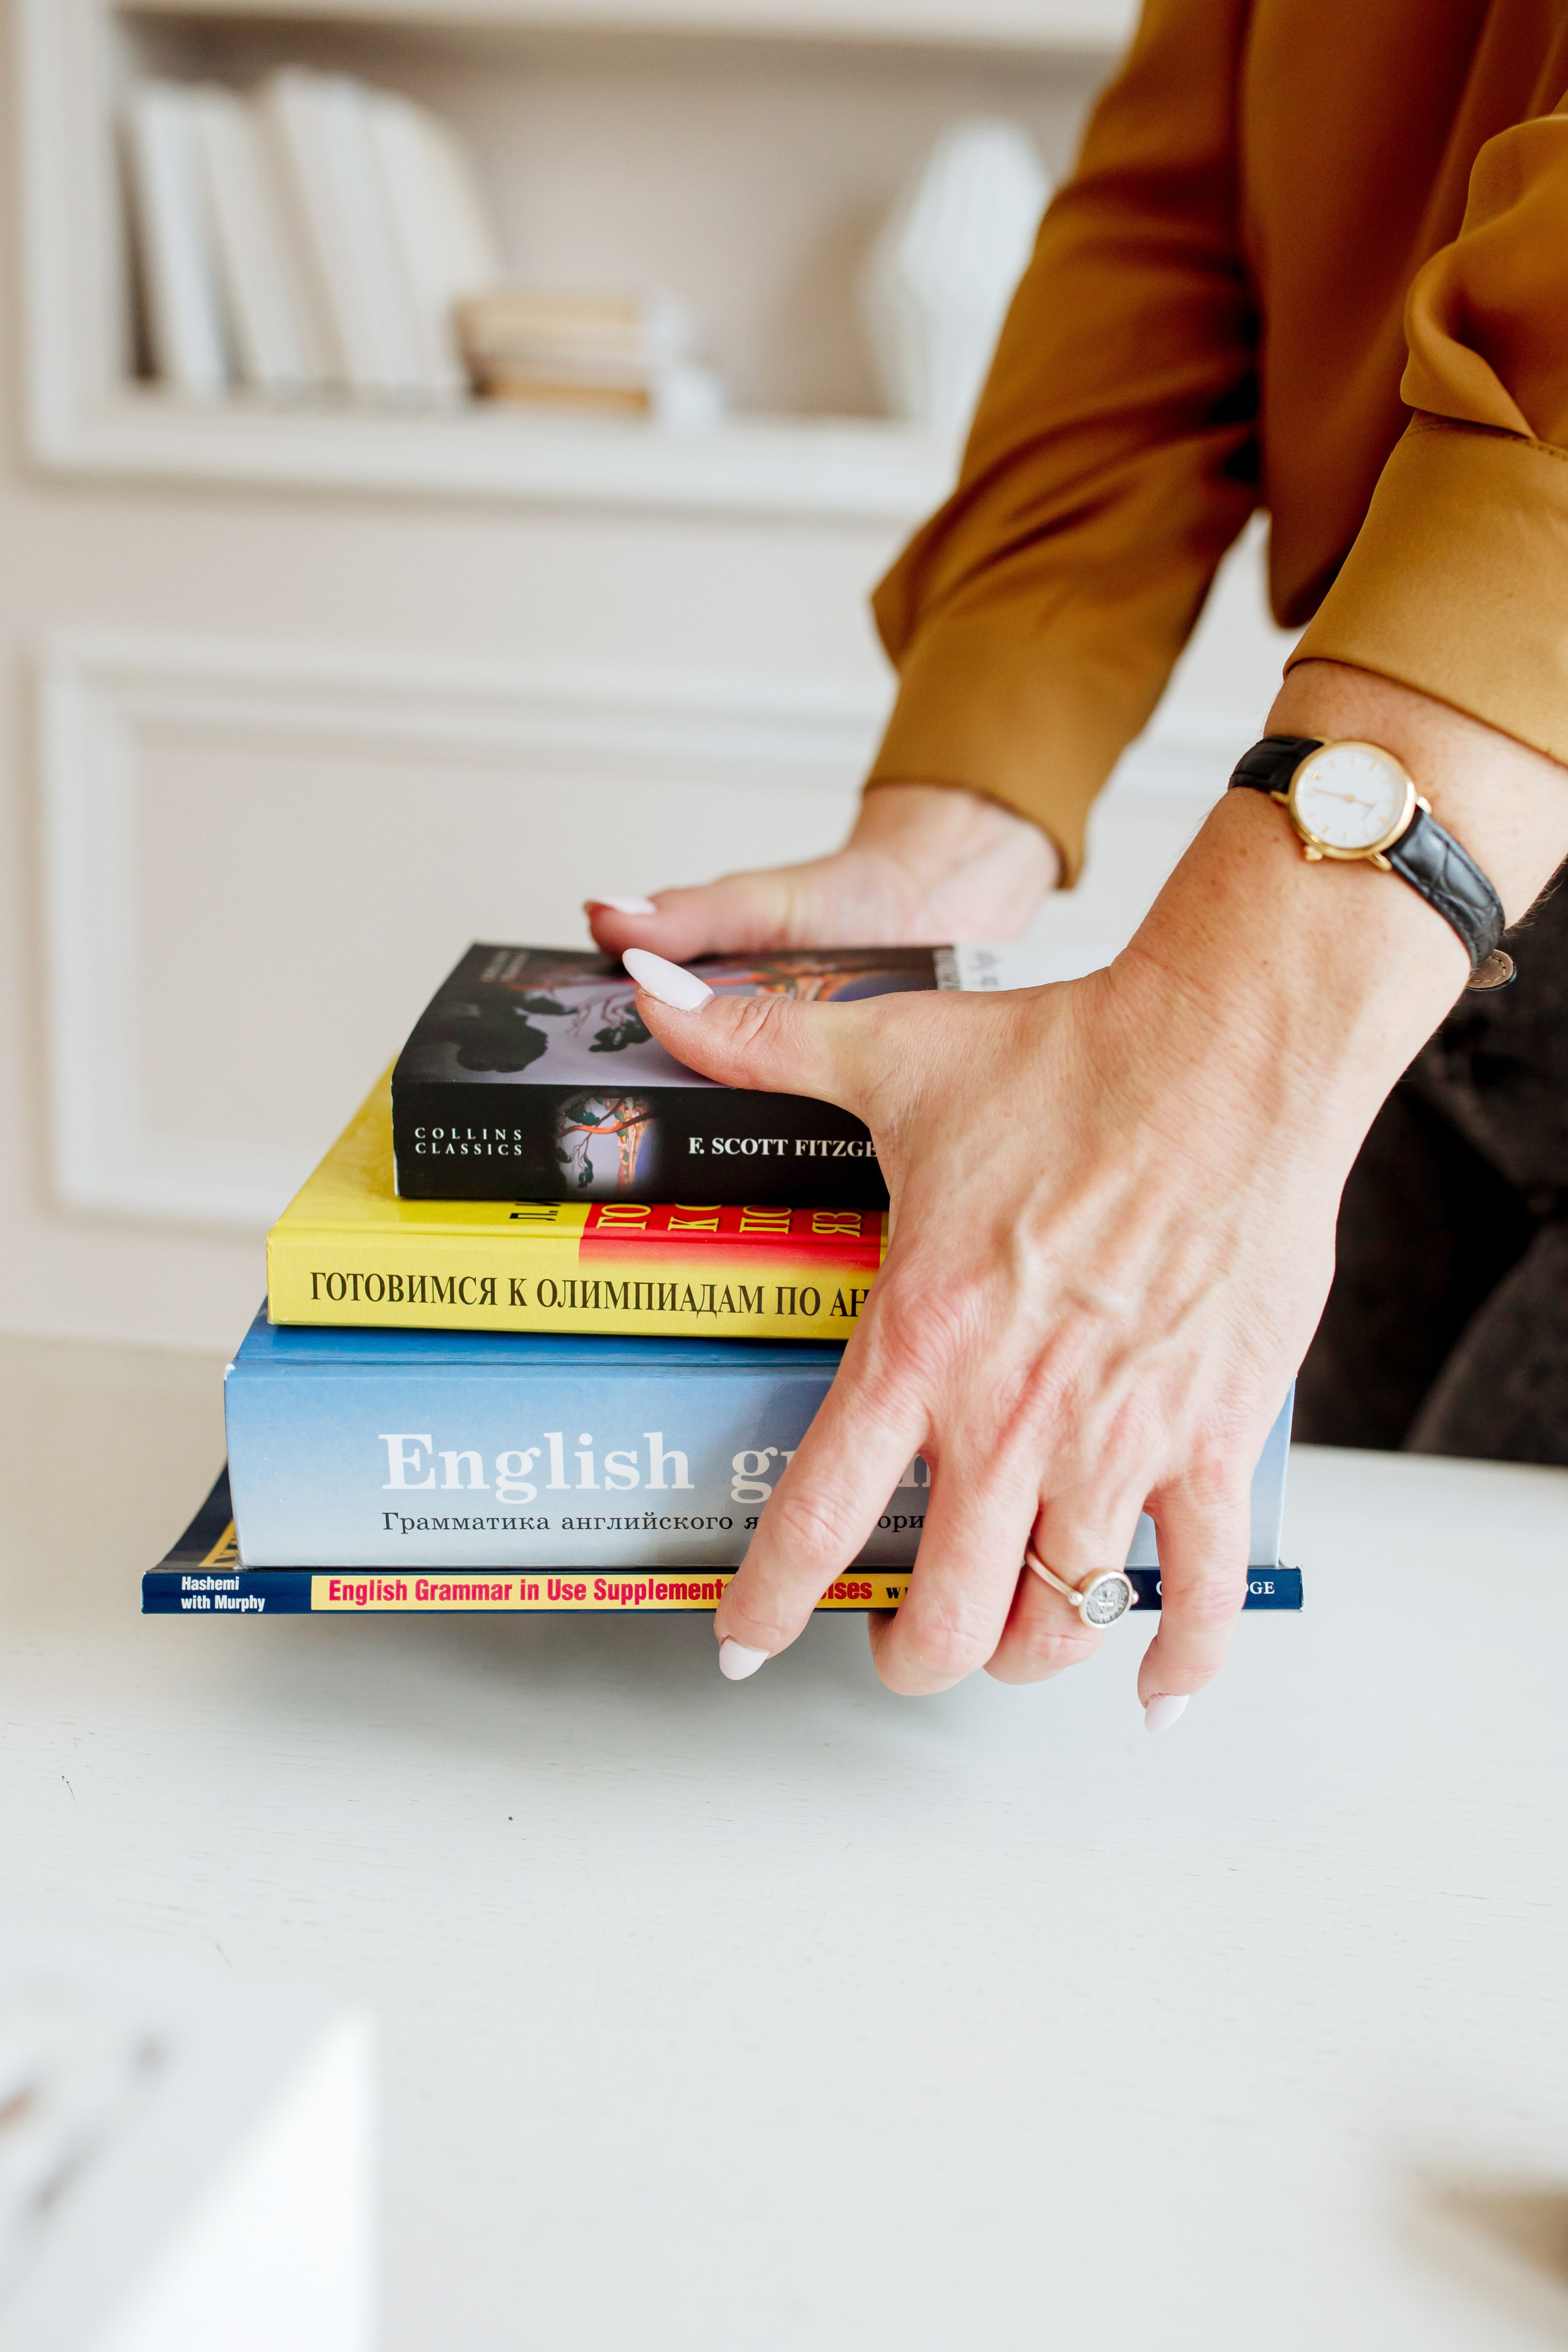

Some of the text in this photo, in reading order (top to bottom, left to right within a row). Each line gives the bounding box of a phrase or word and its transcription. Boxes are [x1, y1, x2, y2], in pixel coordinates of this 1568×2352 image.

[415, 1127, 522, 1141] COLLINS
[688, 1137, 705, 1155] F.
[711, 1137, 789, 1156] SCOTT
[415, 1142, 522, 1156] CLASSICS
[310, 1272, 499, 1306] ГОТОВИМСЯ
[508, 1278, 528, 1307] К
[536, 1278, 765, 1319] ОЛИМПИАДАМ
[775, 1286, 821, 1316] ПО
[378, 1431, 695, 1504] English
[382, 1512, 551, 1534] Грамматика
[561, 1512, 733, 1530] английского
[181, 1576, 265, 1612] Hashemi with Murphy
[329, 1579, 407, 1606] English
[415, 1578, 513, 1602] Grammar
[520, 1578, 540, 1601] in
[547, 1578, 587, 1601] Use
